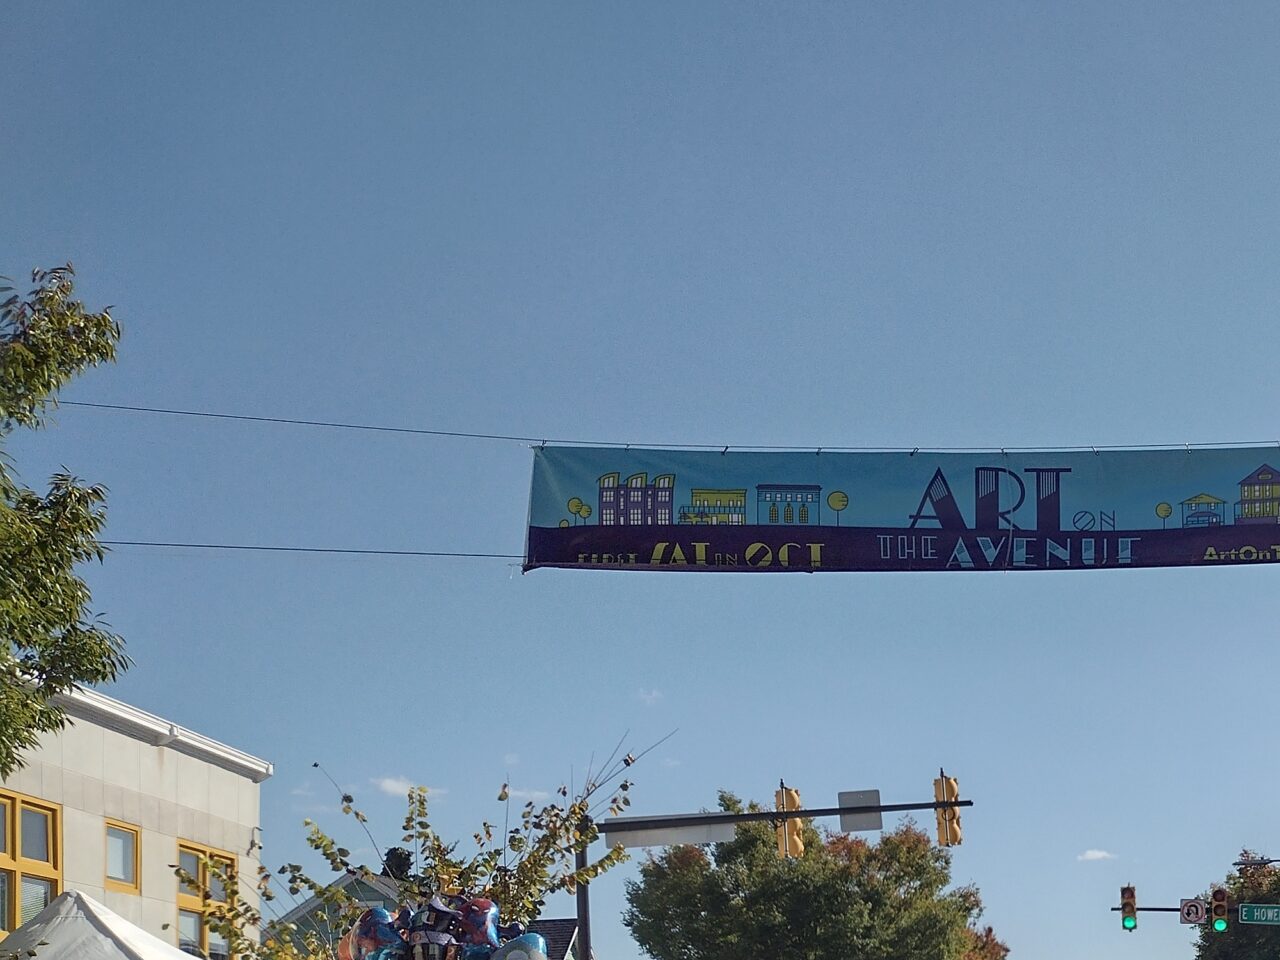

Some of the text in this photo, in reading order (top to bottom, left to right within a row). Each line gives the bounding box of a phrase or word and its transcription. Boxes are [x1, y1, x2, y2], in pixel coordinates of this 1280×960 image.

[909, 467, 1116, 531] ART ON
[877, 535, 938, 559] THE
[1242, 908, 1248, 920] E
